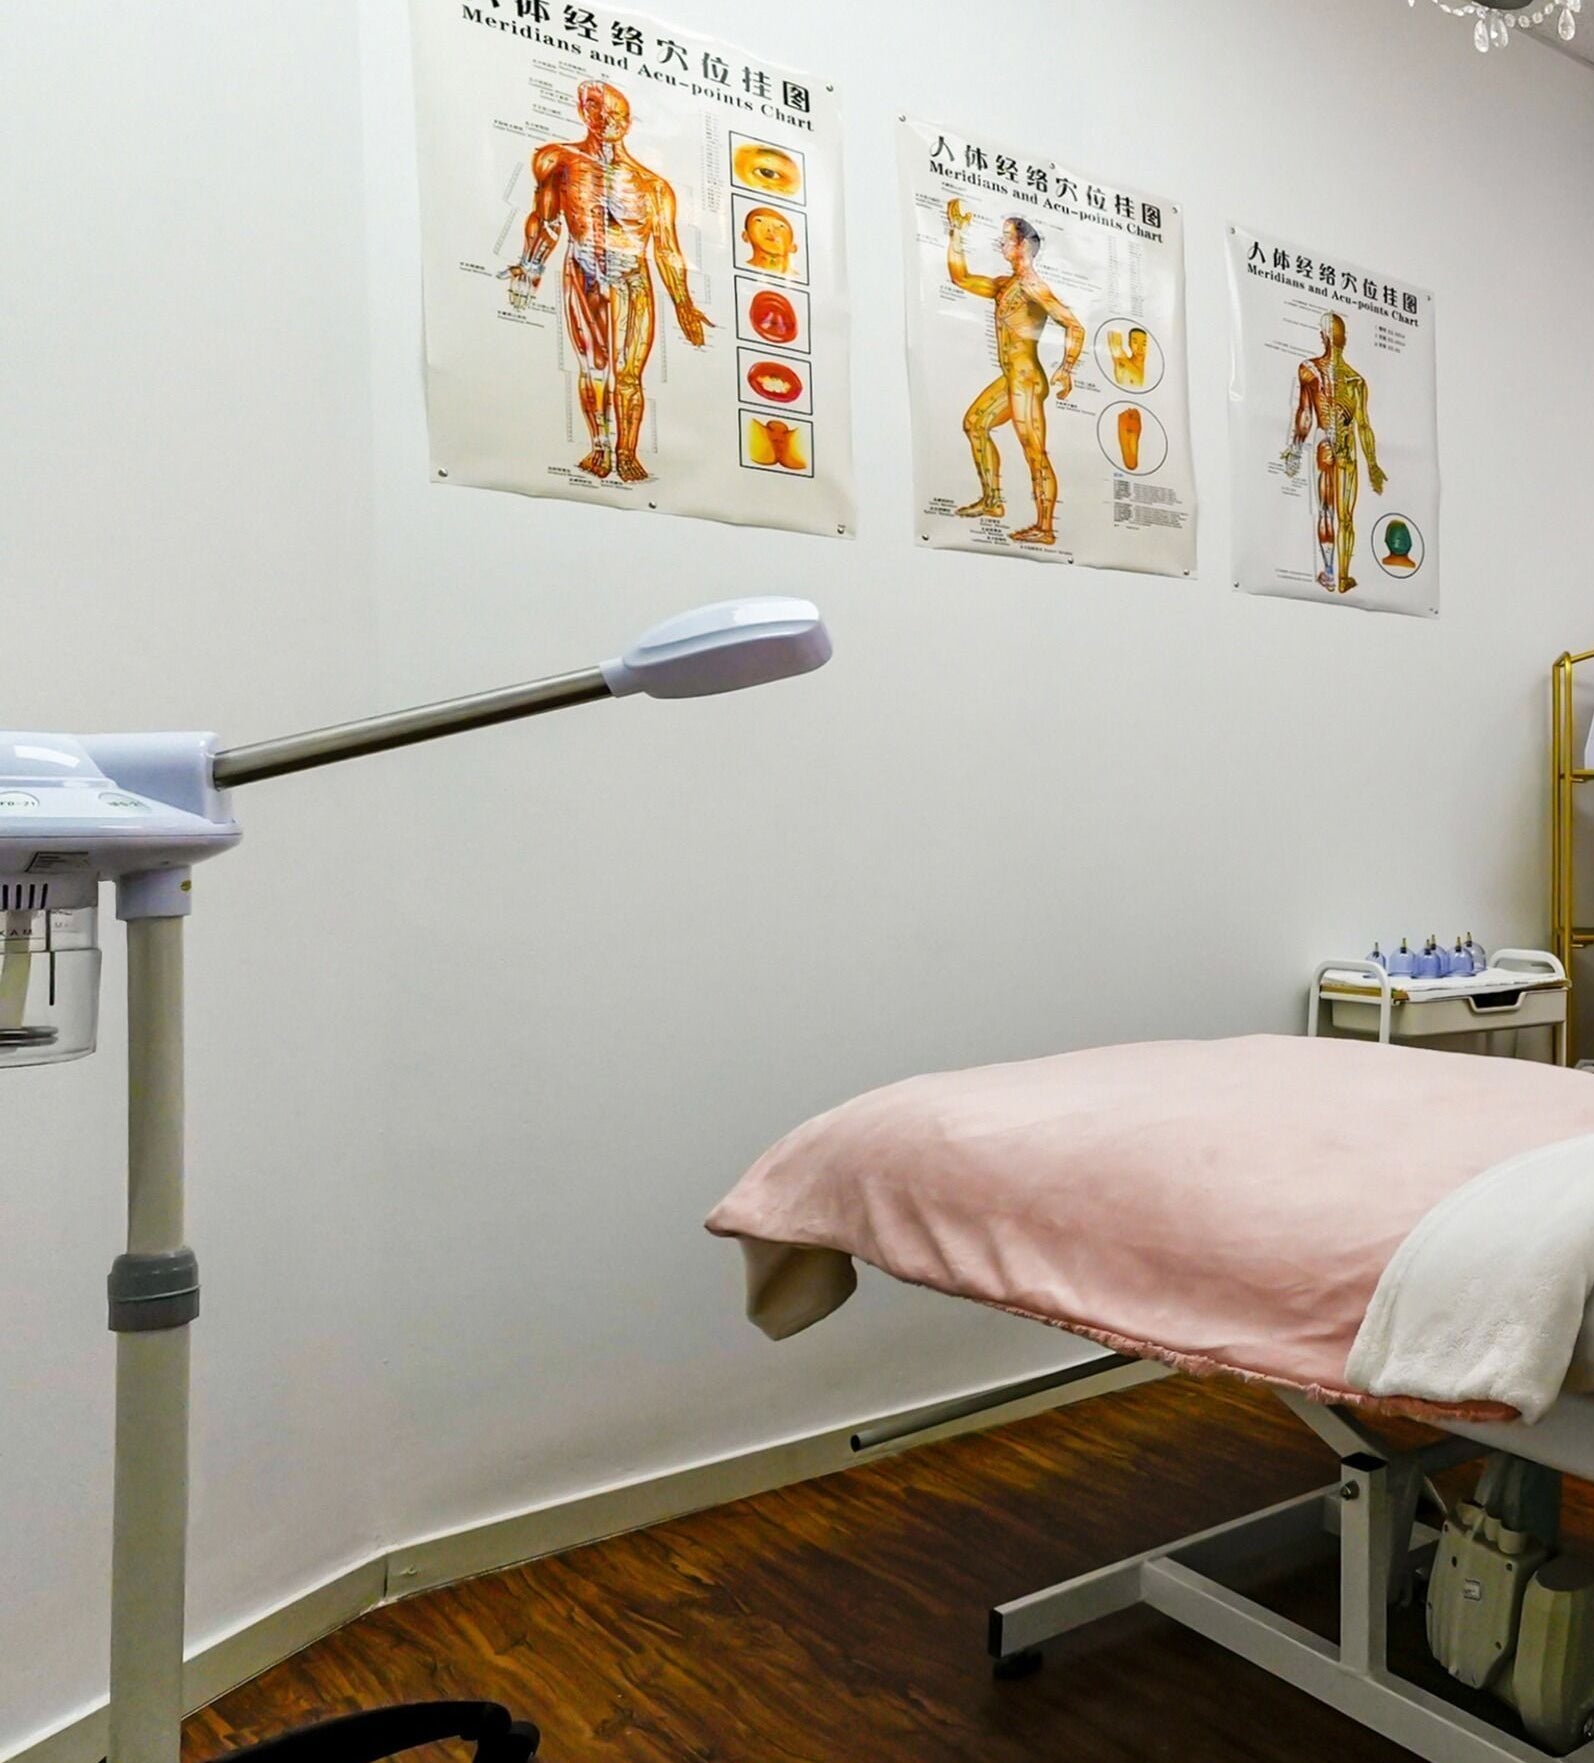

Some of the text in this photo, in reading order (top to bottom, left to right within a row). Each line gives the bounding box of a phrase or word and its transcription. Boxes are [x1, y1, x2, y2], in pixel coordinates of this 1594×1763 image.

[462, 5, 582, 55] Meridians
[590, 47, 629, 71] and
[637, 63, 754, 111] Acu-points
[761, 103, 815, 131] Chart
[465, 0, 810, 113] 体经络穴位挂图
[929, 136, 1161, 229] 人体经络穴位挂图
[929, 160, 1163, 243] Meridians and Acu-points Chart
[1247, 241, 1417, 315] 人体经络穴位挂图
[1247, 263, 1305, 290] Meridians
[1308, 283, 1328, 297] and
[1332, 291, 1389, 317] Acu-points
[1392, 310, 1419, 327] Chart
